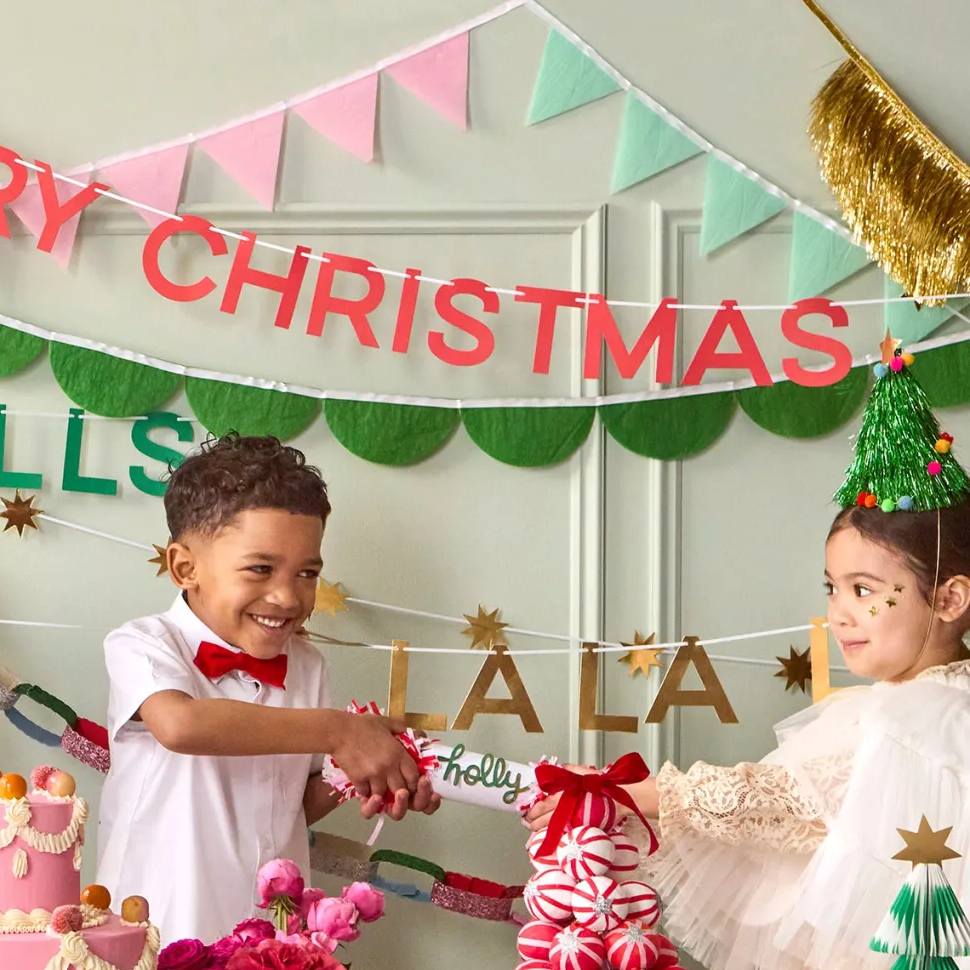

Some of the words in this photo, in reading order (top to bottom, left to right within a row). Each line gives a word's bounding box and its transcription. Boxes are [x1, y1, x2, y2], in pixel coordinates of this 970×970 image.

[142, 214, 852, 388] CHRISTMAS
[387, 640, 544, 733] LA
[578, 636, 739, 733] LA
[437, 743, 530, 804] holly
